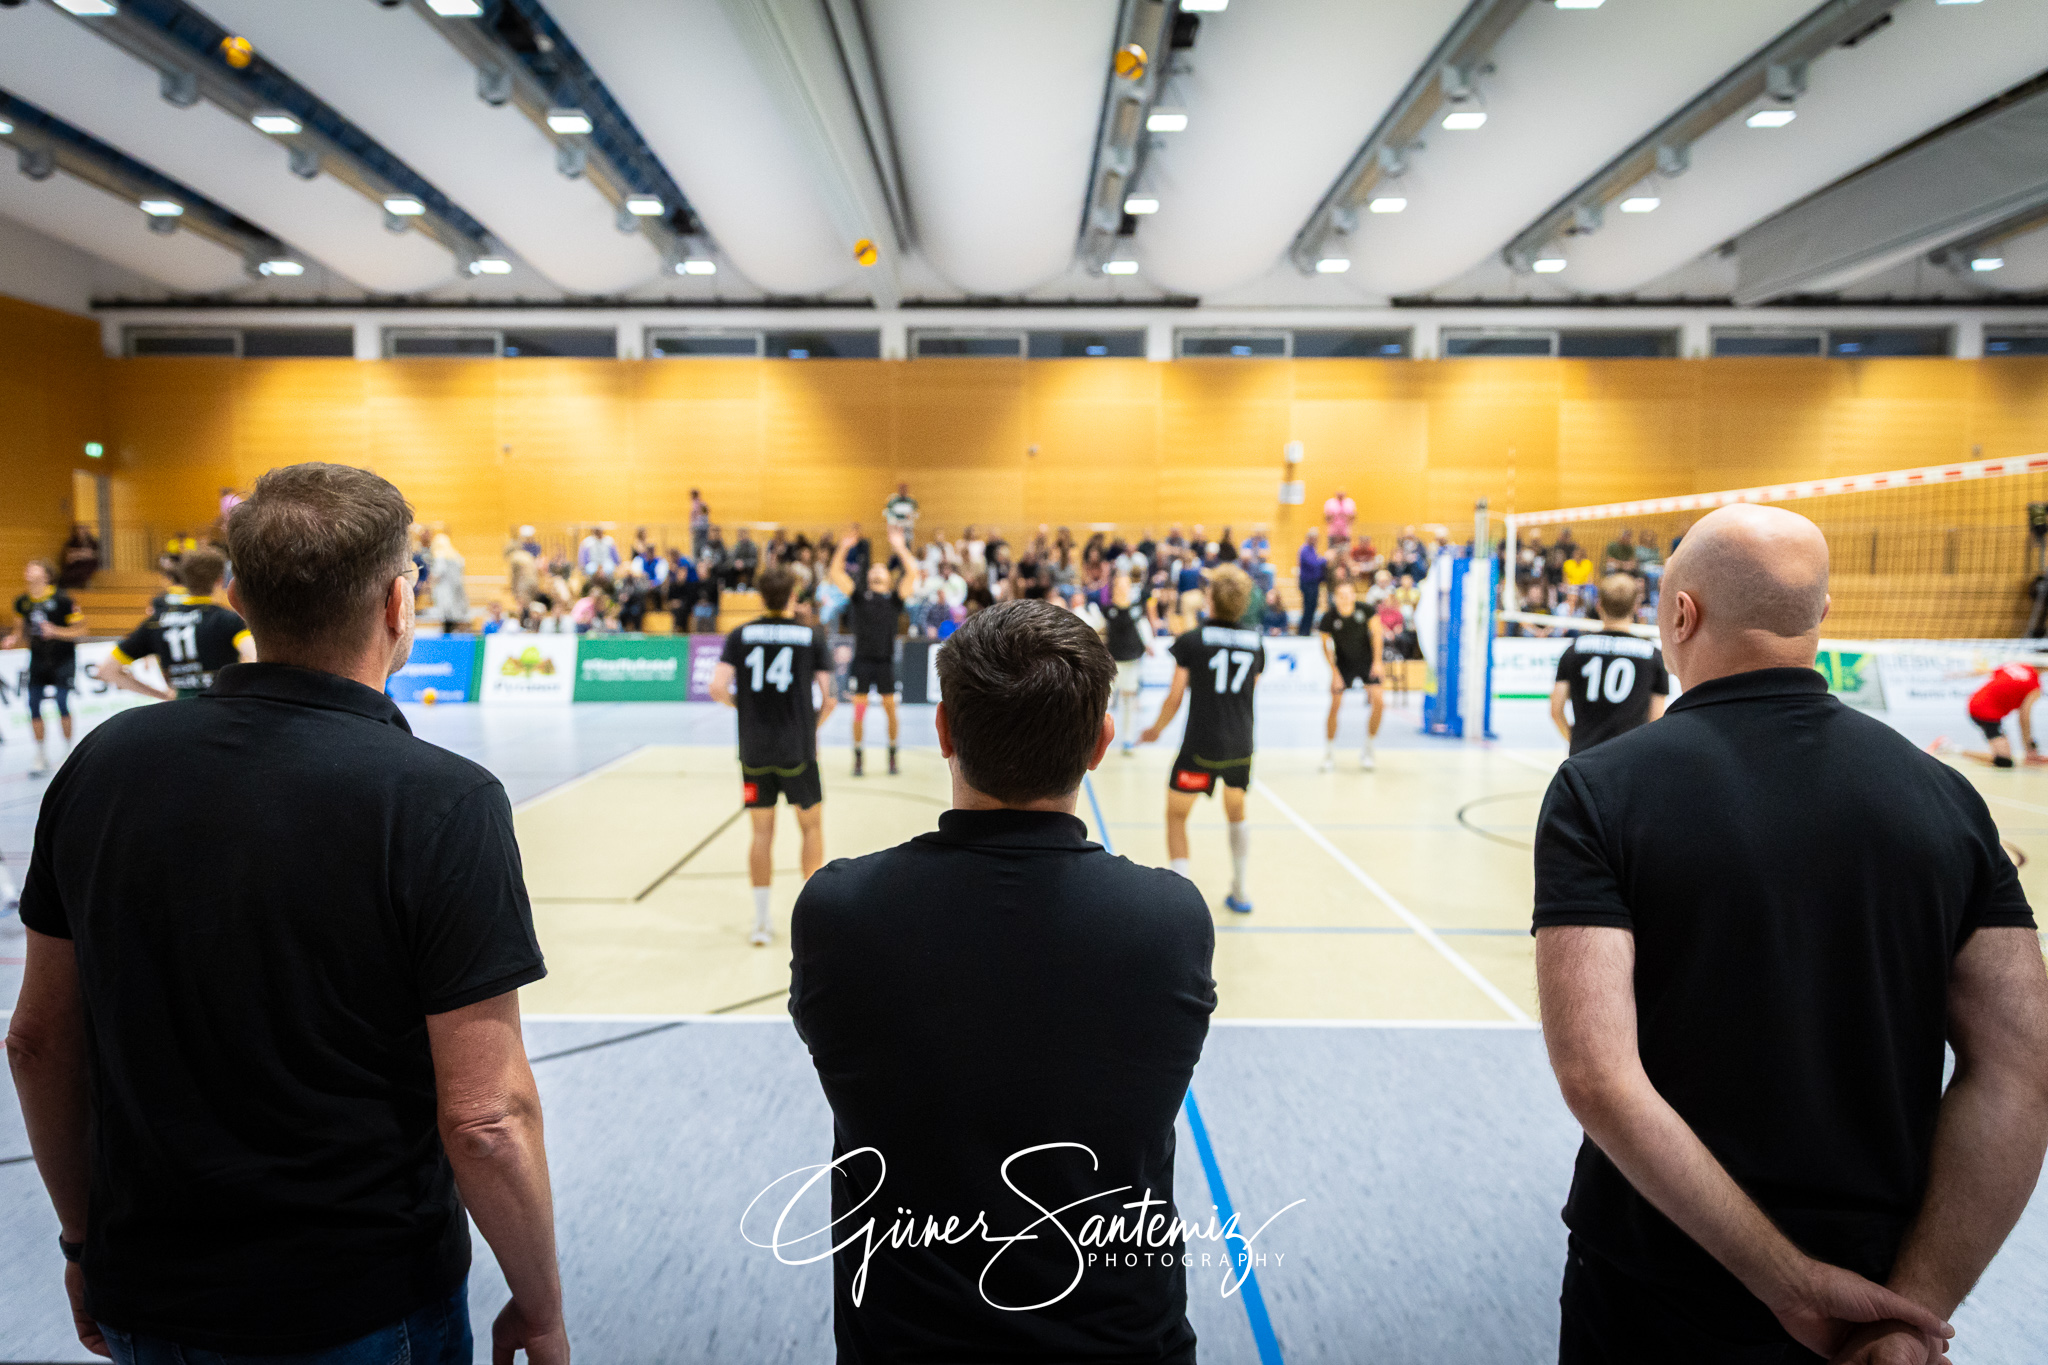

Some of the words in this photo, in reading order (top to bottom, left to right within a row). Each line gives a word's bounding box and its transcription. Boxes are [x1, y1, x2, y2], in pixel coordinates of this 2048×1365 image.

[163, 625, 197, 662] 11
[745, 646, 793, 692] 14
[1209, 648, 1254, 694] 17
[1581, 656, 1636, 703] 10
